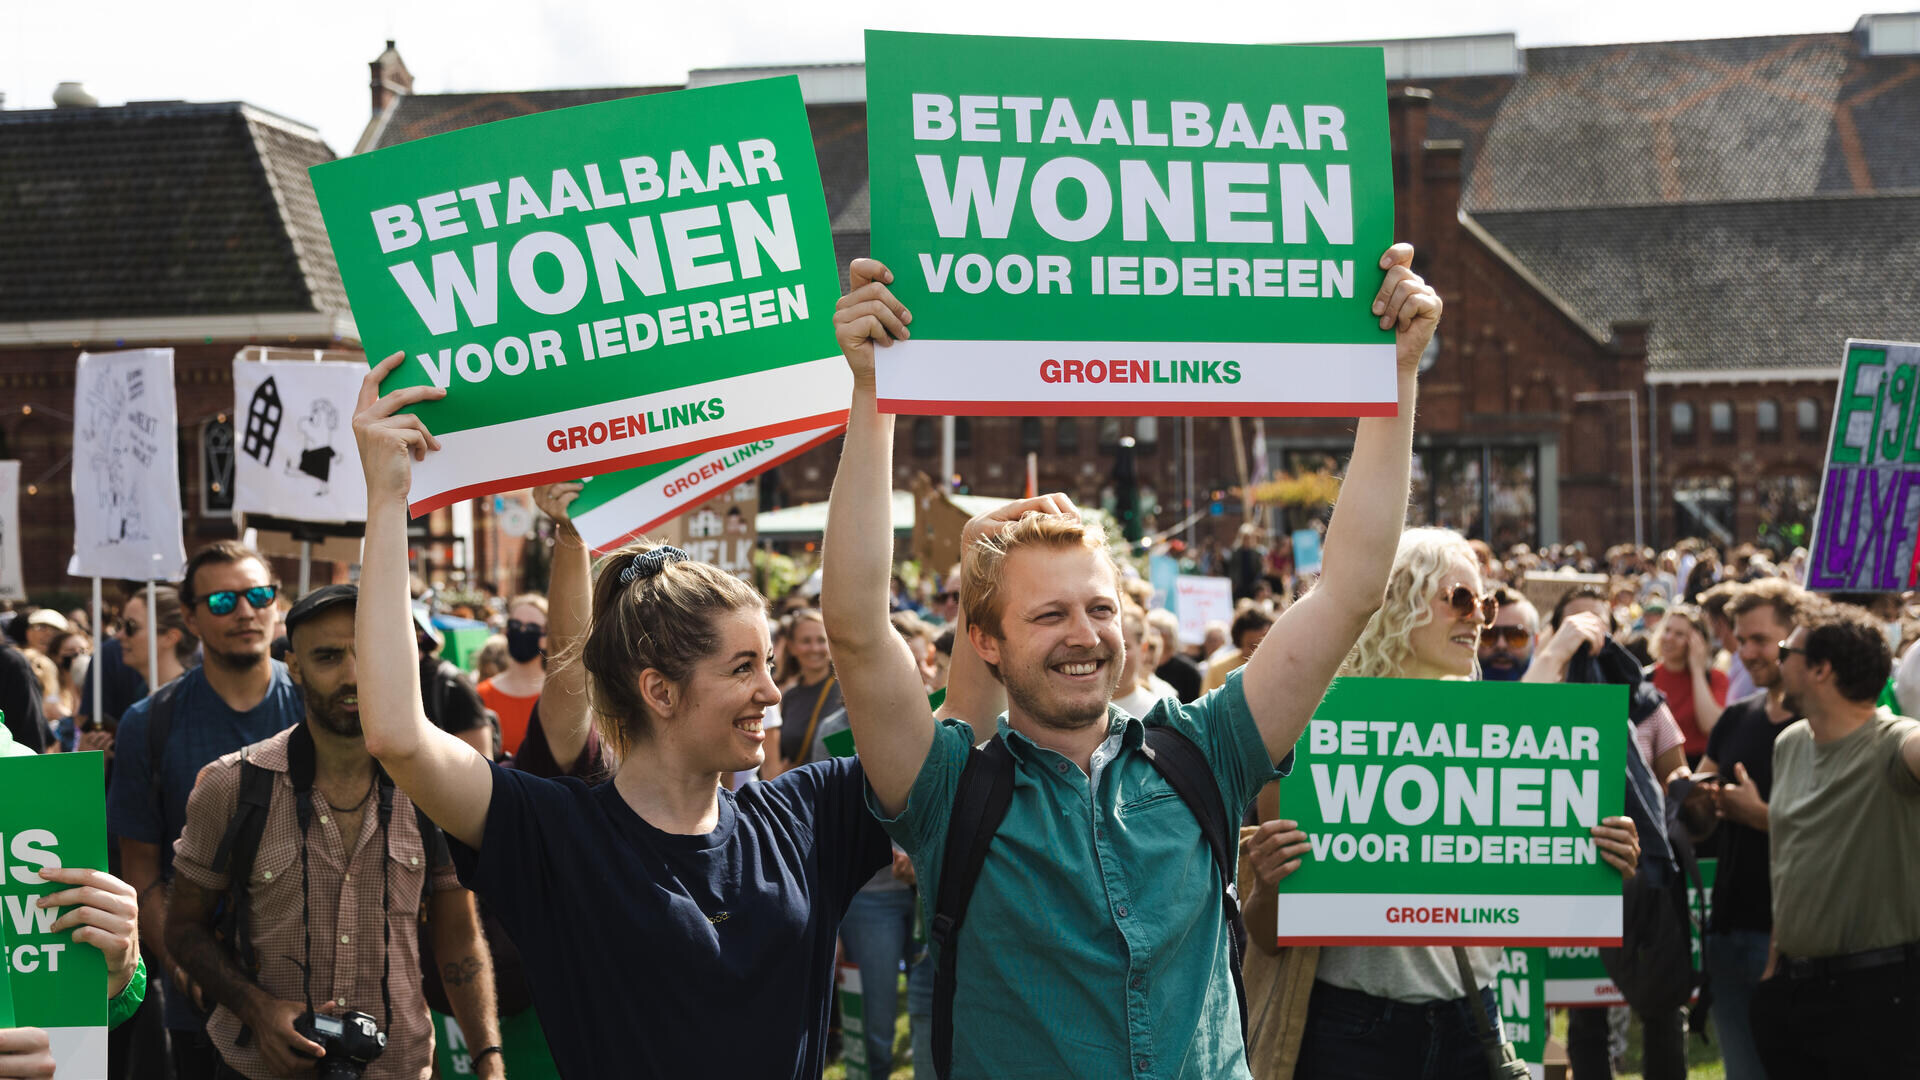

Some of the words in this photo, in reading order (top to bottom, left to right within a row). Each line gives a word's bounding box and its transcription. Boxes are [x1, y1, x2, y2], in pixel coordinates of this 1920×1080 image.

[912, 93, 1348, 150] BETAALBAAR
[370, 138, 783, 253] BETAALBAAR
[915, 154, 1354, 245] WONEN
[388, 194, 801, 336] WONEN
[918, 253, 1072, 294] VOOR
[1091, 256, 1354, 298] IEDEREEN
[417, 330, 567, 388] VOOR
[578, 284, 809, 360] IEDEREEN
[1039, 360, 1241, 384] GROENLINKS
[547, 397, 725, 453] GROENLINKS
[663, 440, 774, 498] GROENLINKS
[1811, 468, 1920, 589] LUXE
[1309, 720, 1600, 761] BETAALBAAR
[1311, 763, 1600, 828] WONEN
[1309, 834, 1410, 863] VOOR
[1421, 835, 1597, 865] IEDEREEN
[1386, 907, 1520, 924] GROENLINKS
